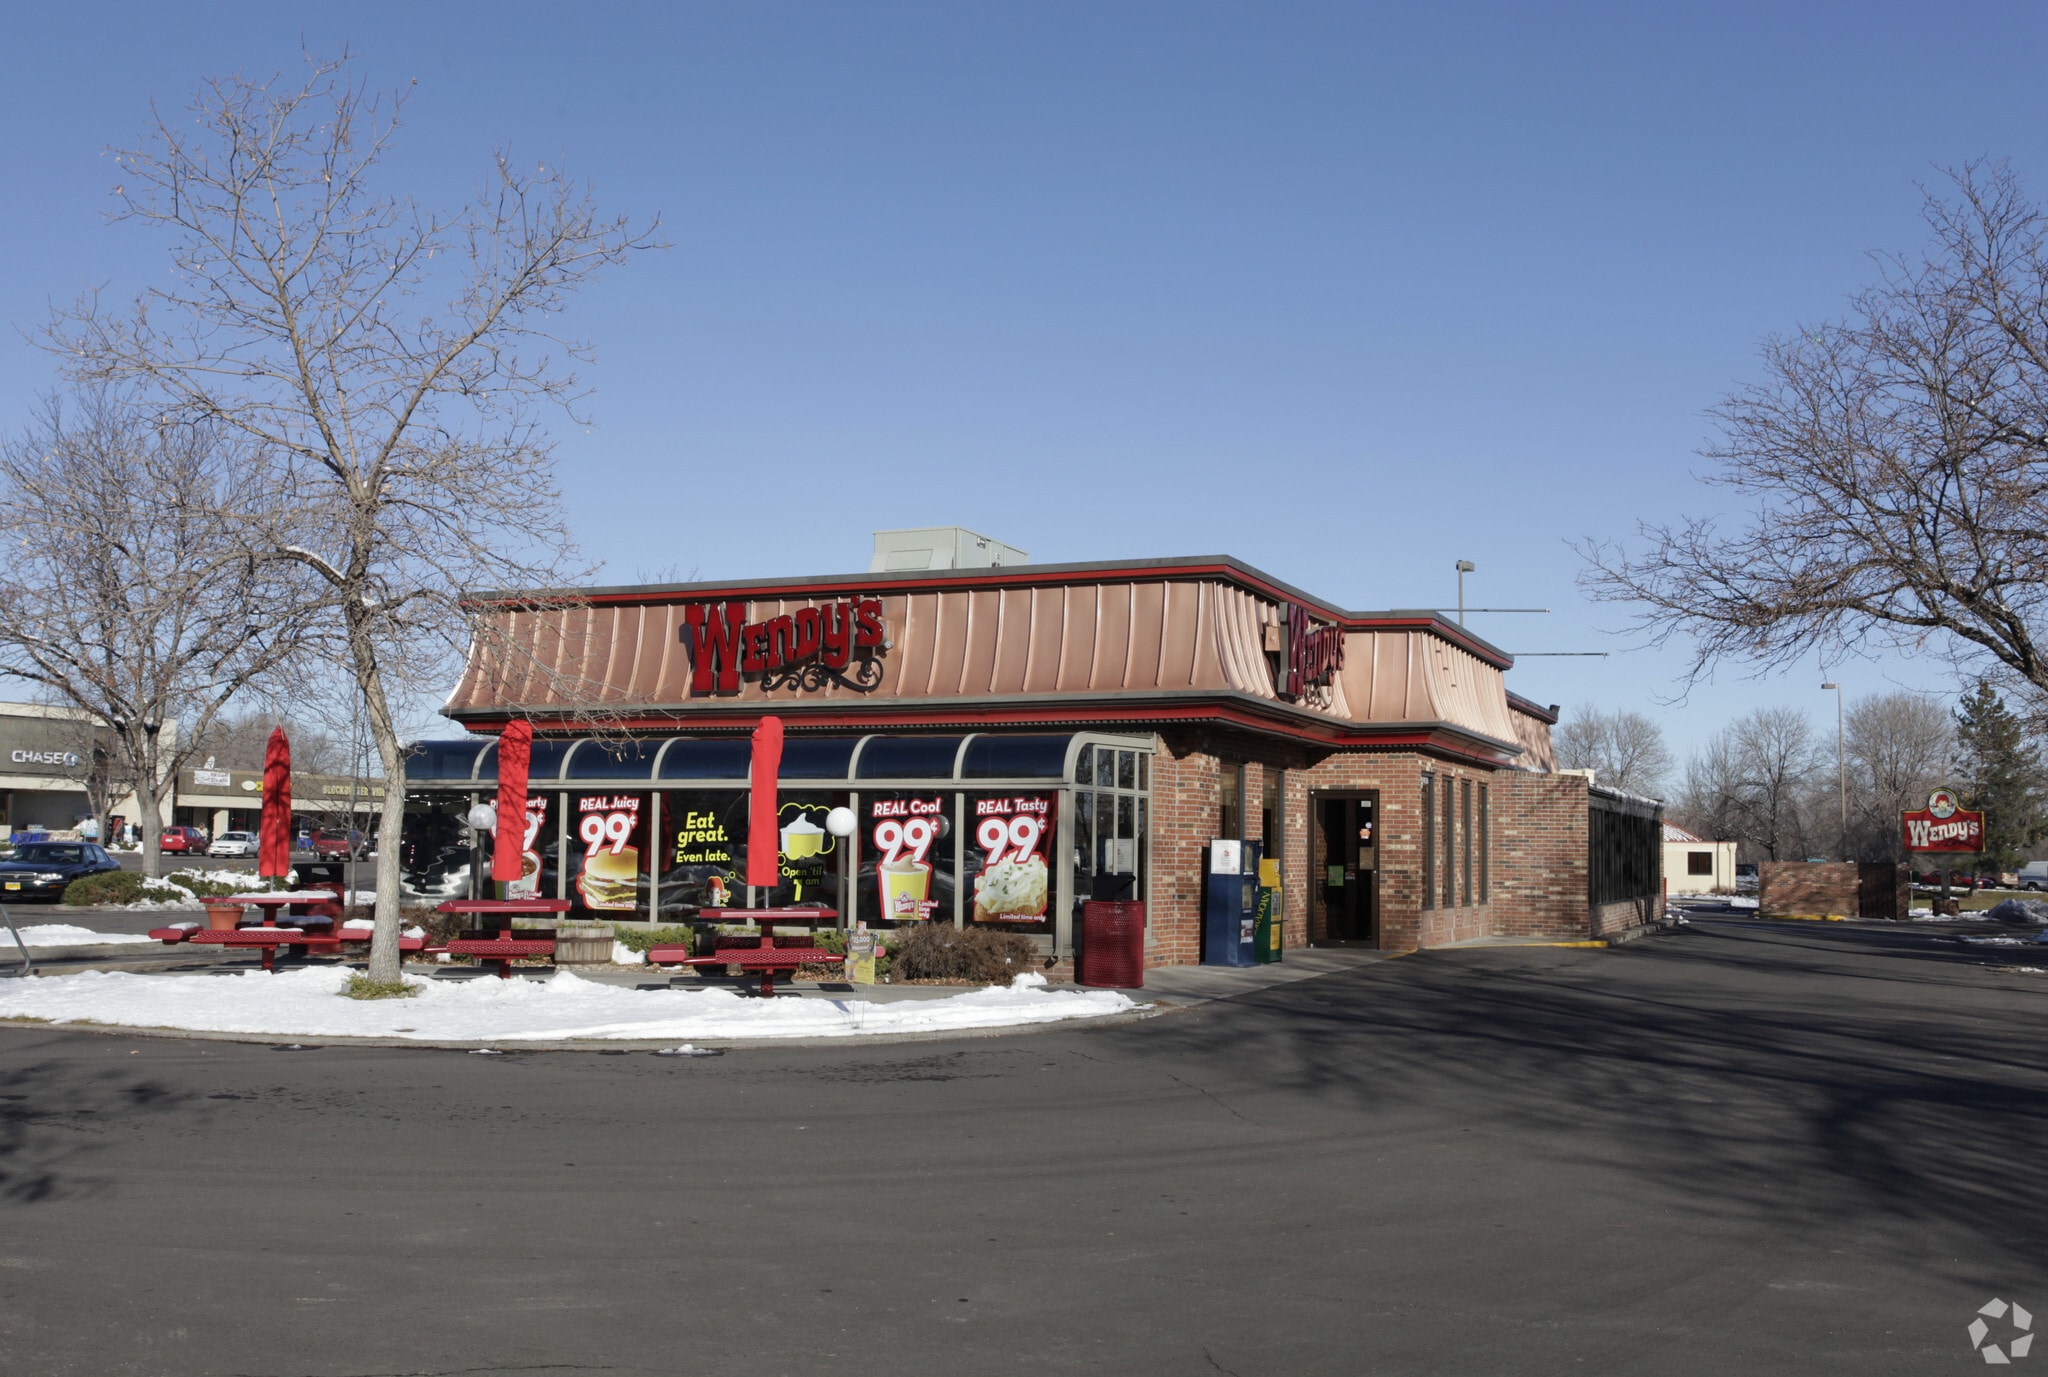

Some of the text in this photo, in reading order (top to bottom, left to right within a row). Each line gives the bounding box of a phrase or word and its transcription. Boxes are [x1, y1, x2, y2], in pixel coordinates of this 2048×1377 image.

[685, 595, 886, 691] Wendy's
[11, 750, 63, 765] CHASE
[580, 796, 640, 810] REAL Juicy
[874, 798, 941, 816] REAL Cool
[977, 798, 1047, 814] REAL Tasty
[686, 811, 715, 829] Eat
[677, 825, 729, 848] great.
[1907, 820, 1979, 847] Wendy's
[676, 849, 731, 862] Even late.
[781, 866, 807, 879] Open
